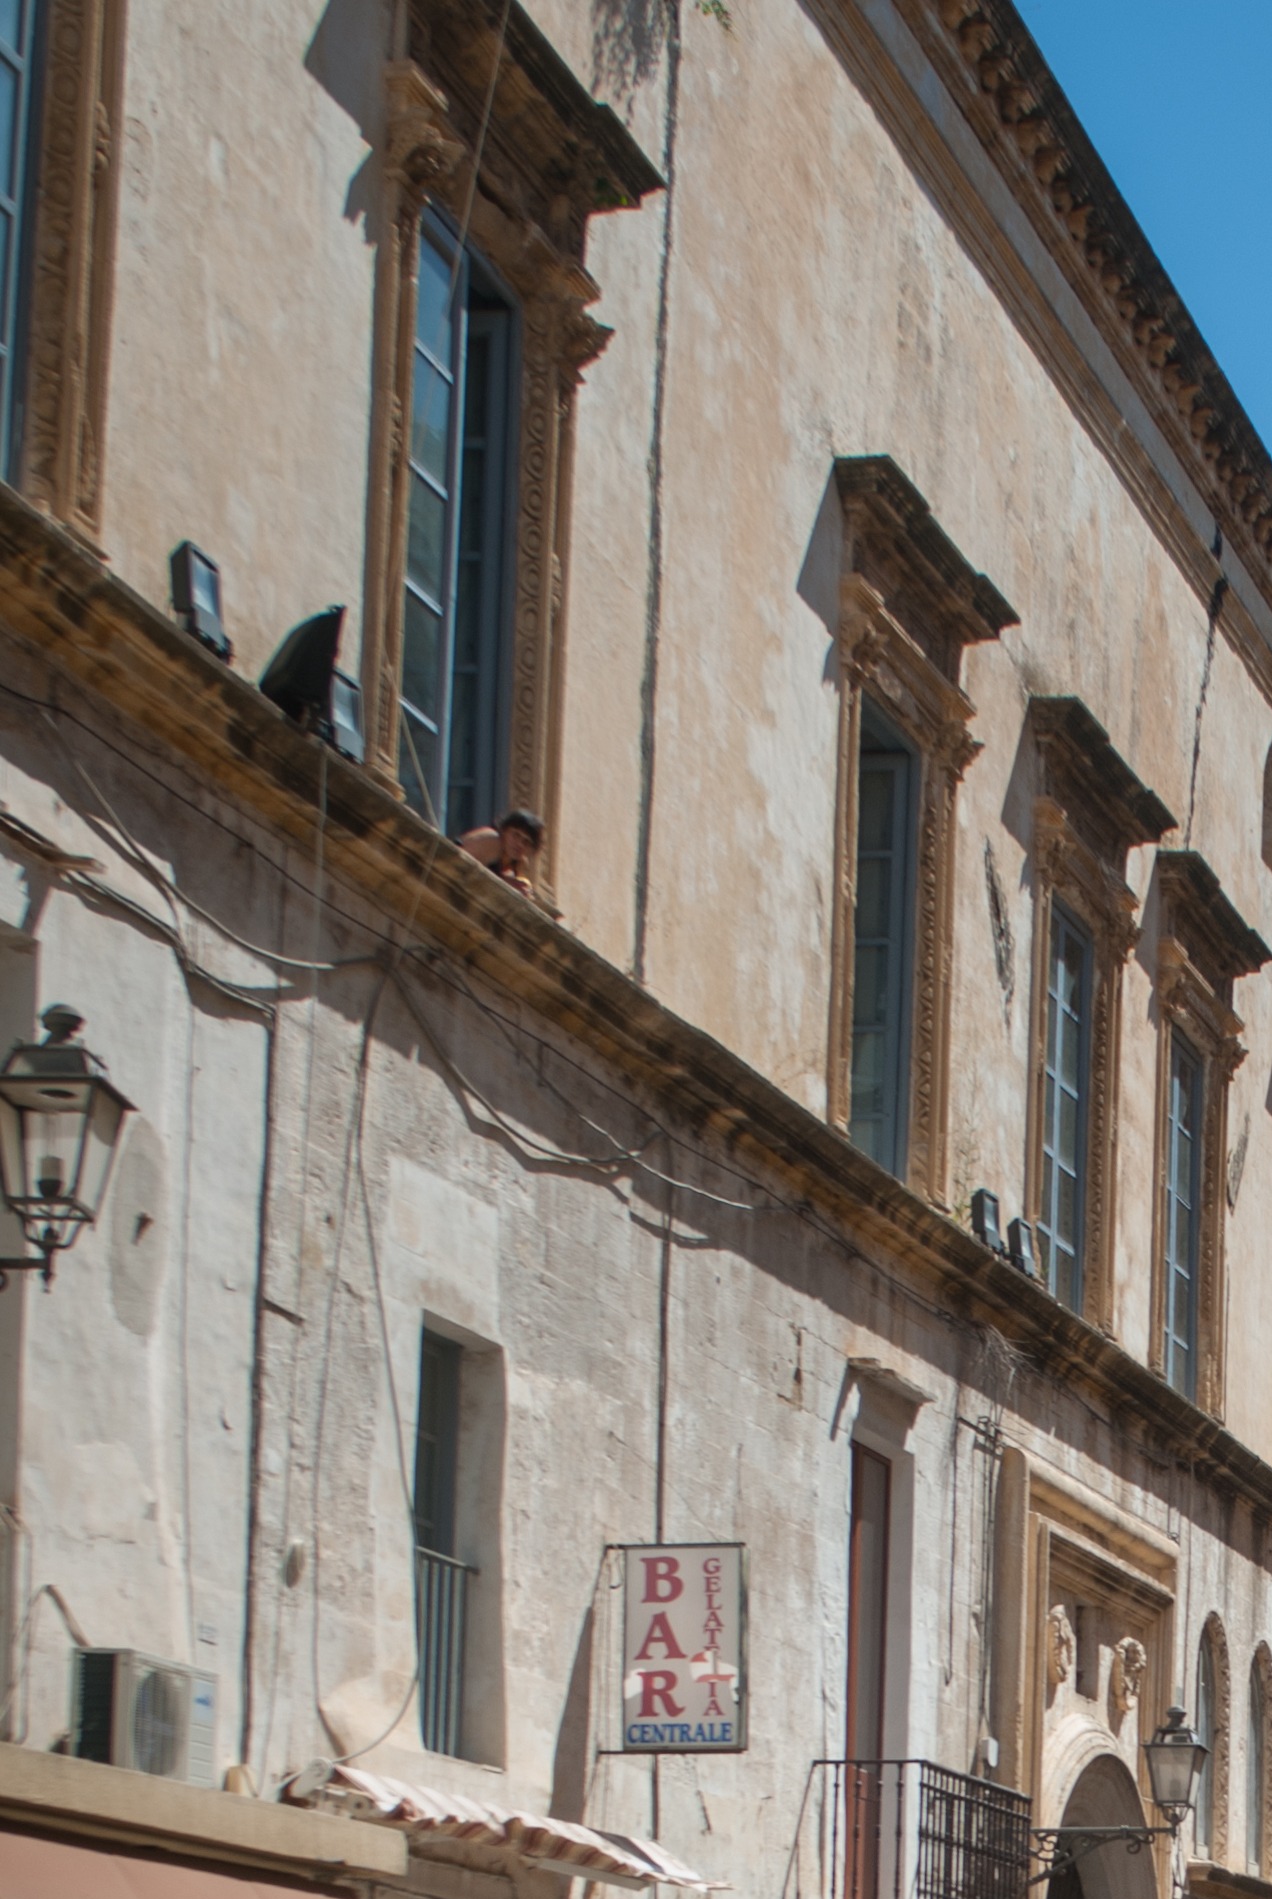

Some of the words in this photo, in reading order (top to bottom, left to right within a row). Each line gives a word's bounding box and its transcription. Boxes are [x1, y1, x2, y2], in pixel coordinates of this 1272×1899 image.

[634, 1556, 688, 1717] BAR
[702, 1557, 725, 1716] GELATIA
[627, 1722, 733, 1744] CENTRALE
